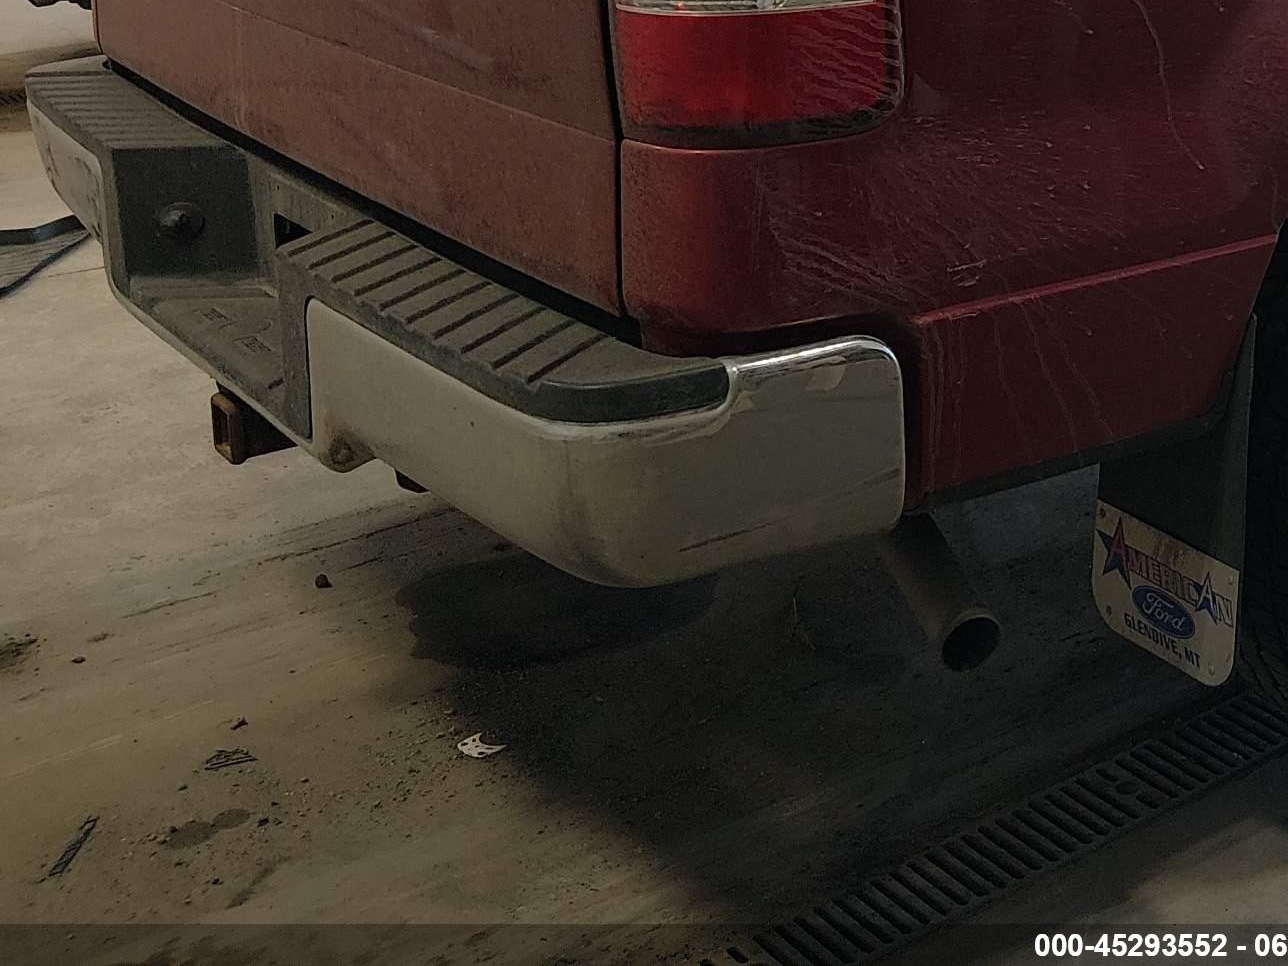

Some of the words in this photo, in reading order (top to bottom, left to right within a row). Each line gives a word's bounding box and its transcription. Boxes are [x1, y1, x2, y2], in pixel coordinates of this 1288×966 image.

[1096, 516, 1233, 628] AMERICAN
[1141, 591, 1185, 632] Ford
[1184, 646, 1201, 668] MT
